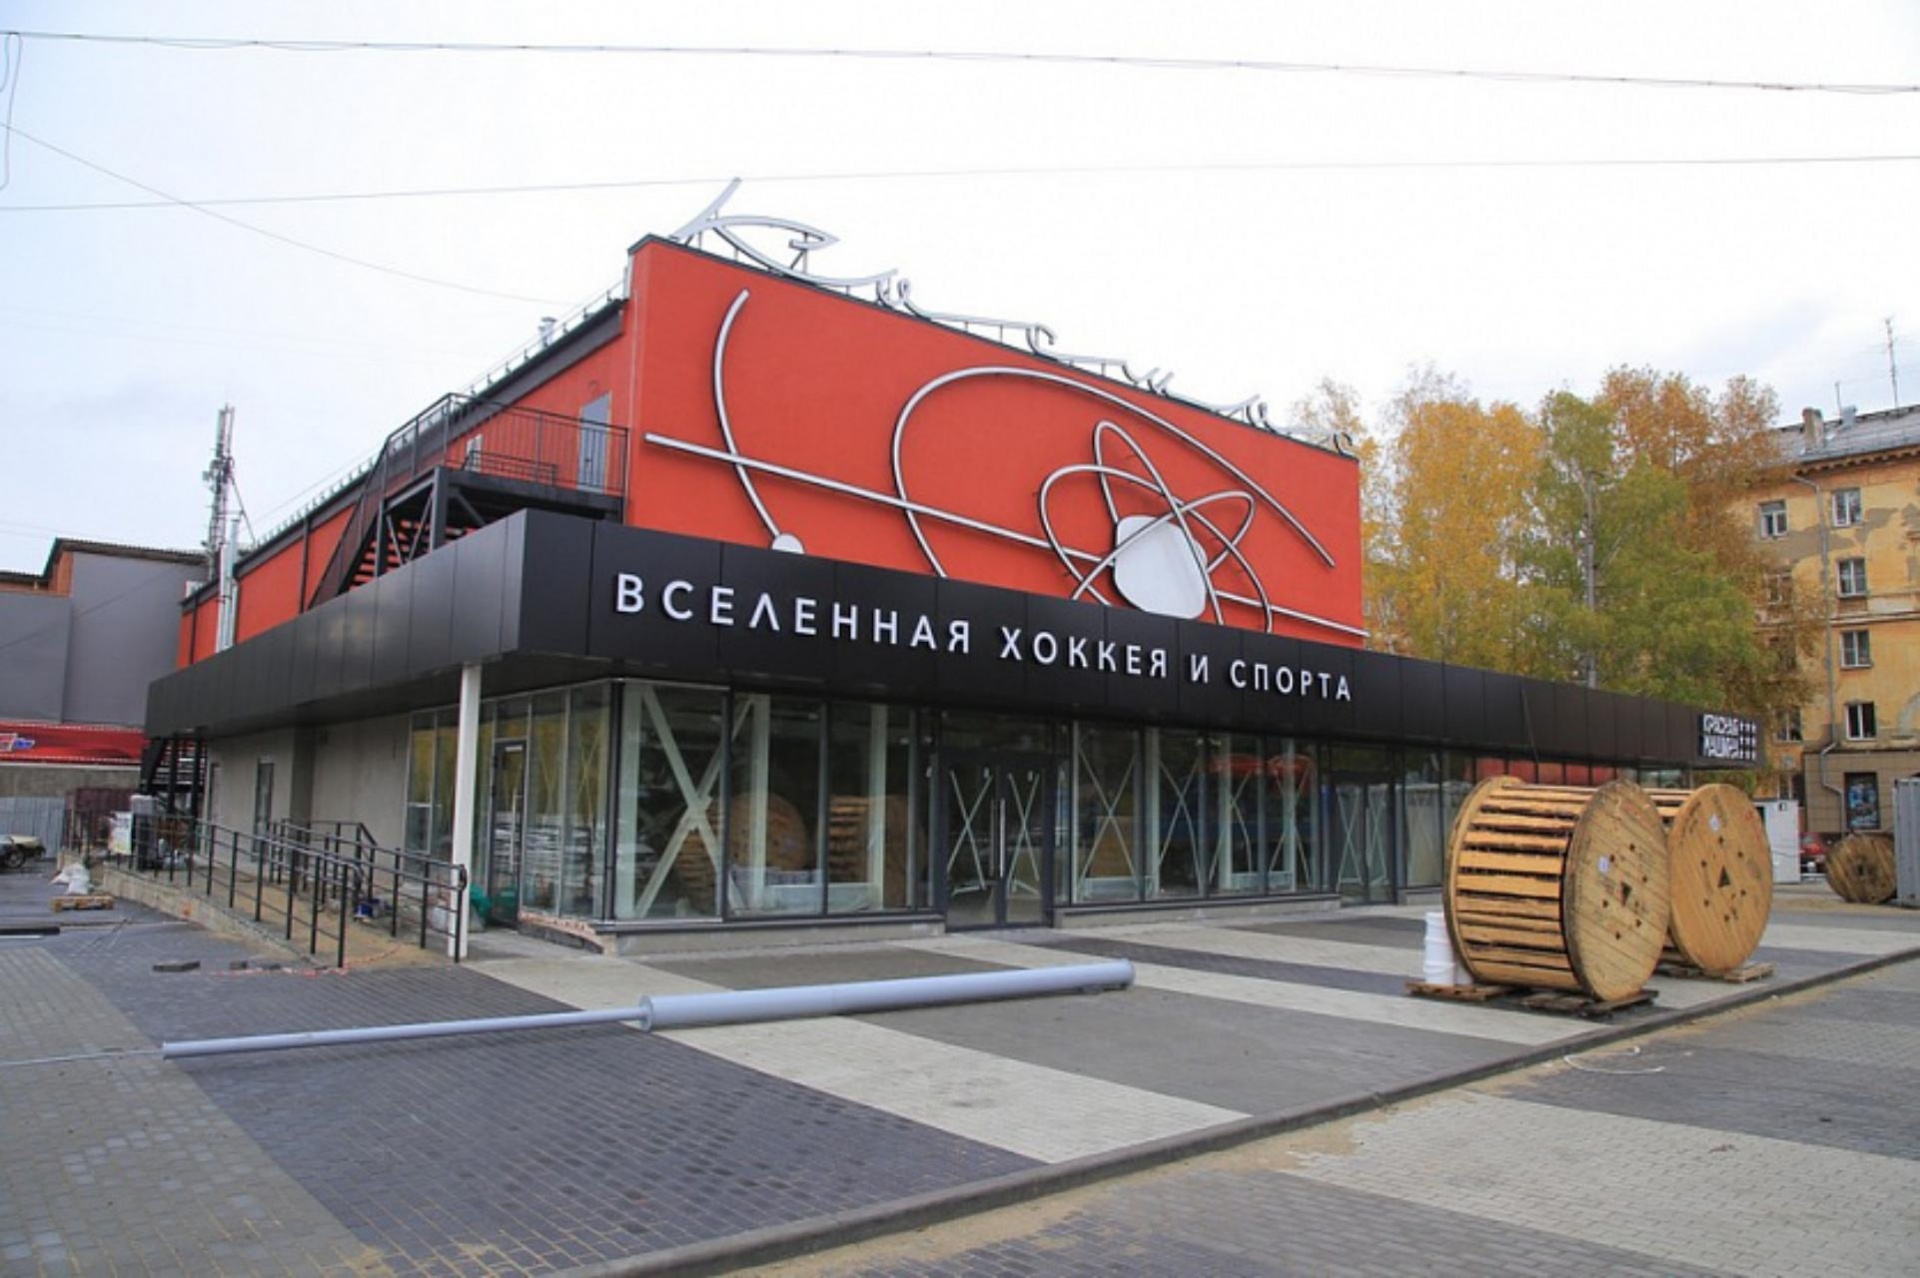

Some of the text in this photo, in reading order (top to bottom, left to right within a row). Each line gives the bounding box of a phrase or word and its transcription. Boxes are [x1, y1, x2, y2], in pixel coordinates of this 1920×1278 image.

[615, 572, 1351, 701] ВСЕЛЕННАЯ ХОККЕЯ И СПОРТА
